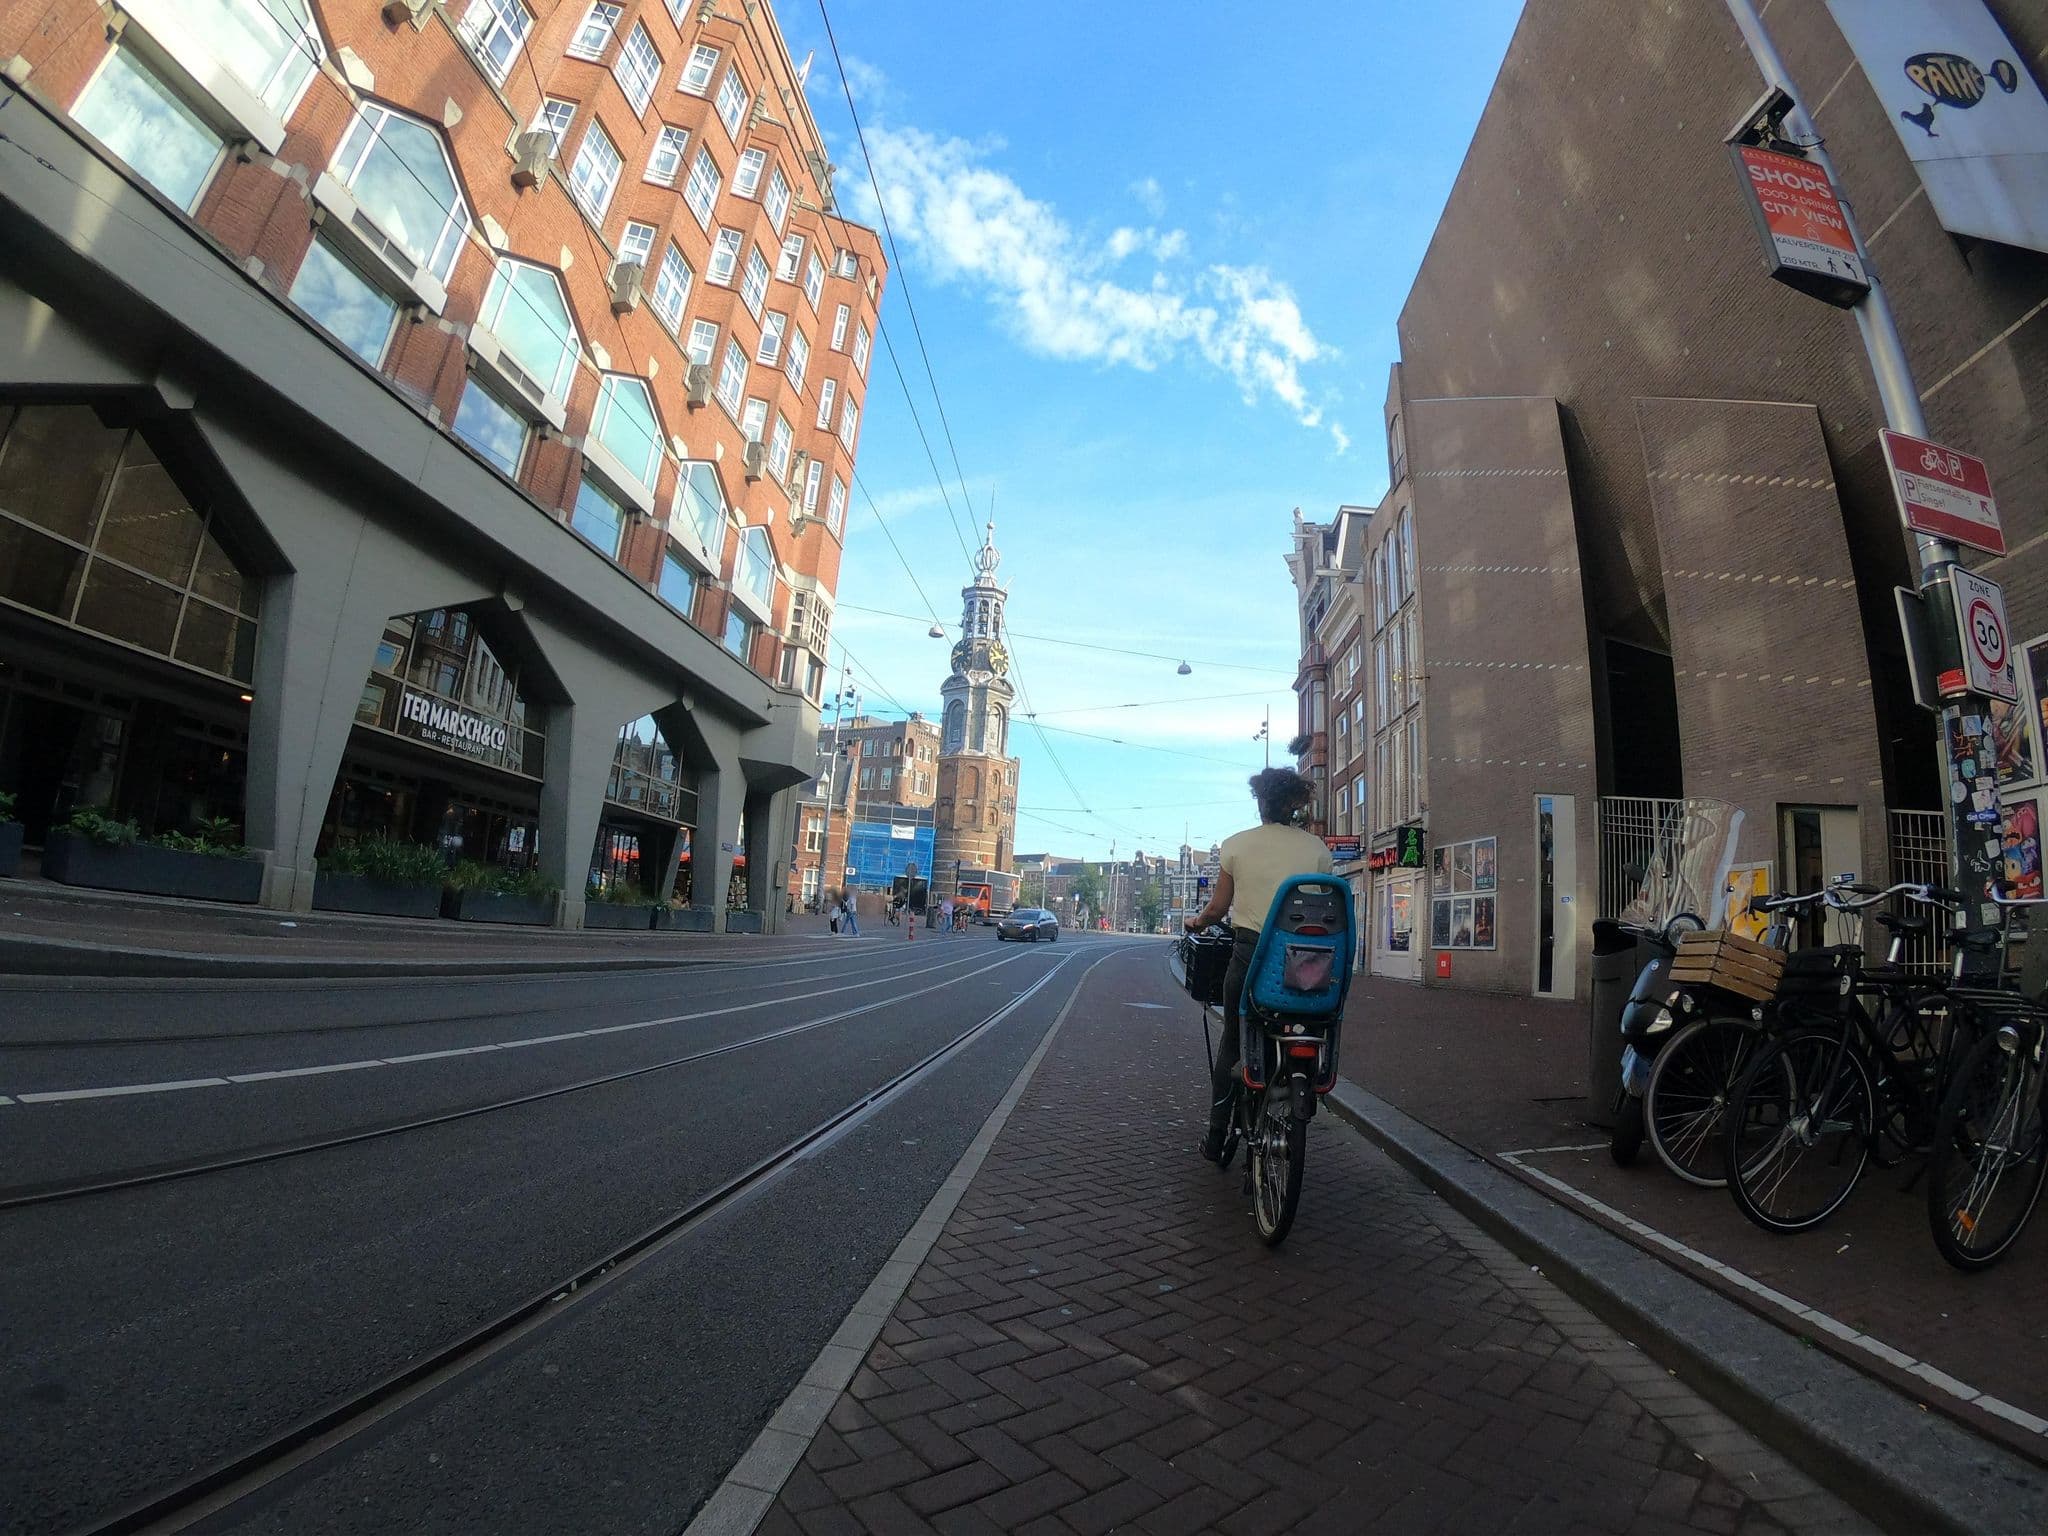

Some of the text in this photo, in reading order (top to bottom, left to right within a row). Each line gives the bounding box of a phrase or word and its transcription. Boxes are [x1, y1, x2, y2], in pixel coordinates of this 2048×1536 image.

[1748, 164, 1832, 199] SHOPS
[1757, 187, 1789, 200] FOOD
[1799, 196, 1838, 214] DRINKS
[1762, 201, 1843, 230] CITY VIEW
[1921, 493, 1945, 509] Singel
[1969, 580, 1991, 598] ZONE
[1977, 620, 1999, 650] 30
[421, 727, 437, 741] BAR
[441, 734, 485, 756] RESTAURANT
